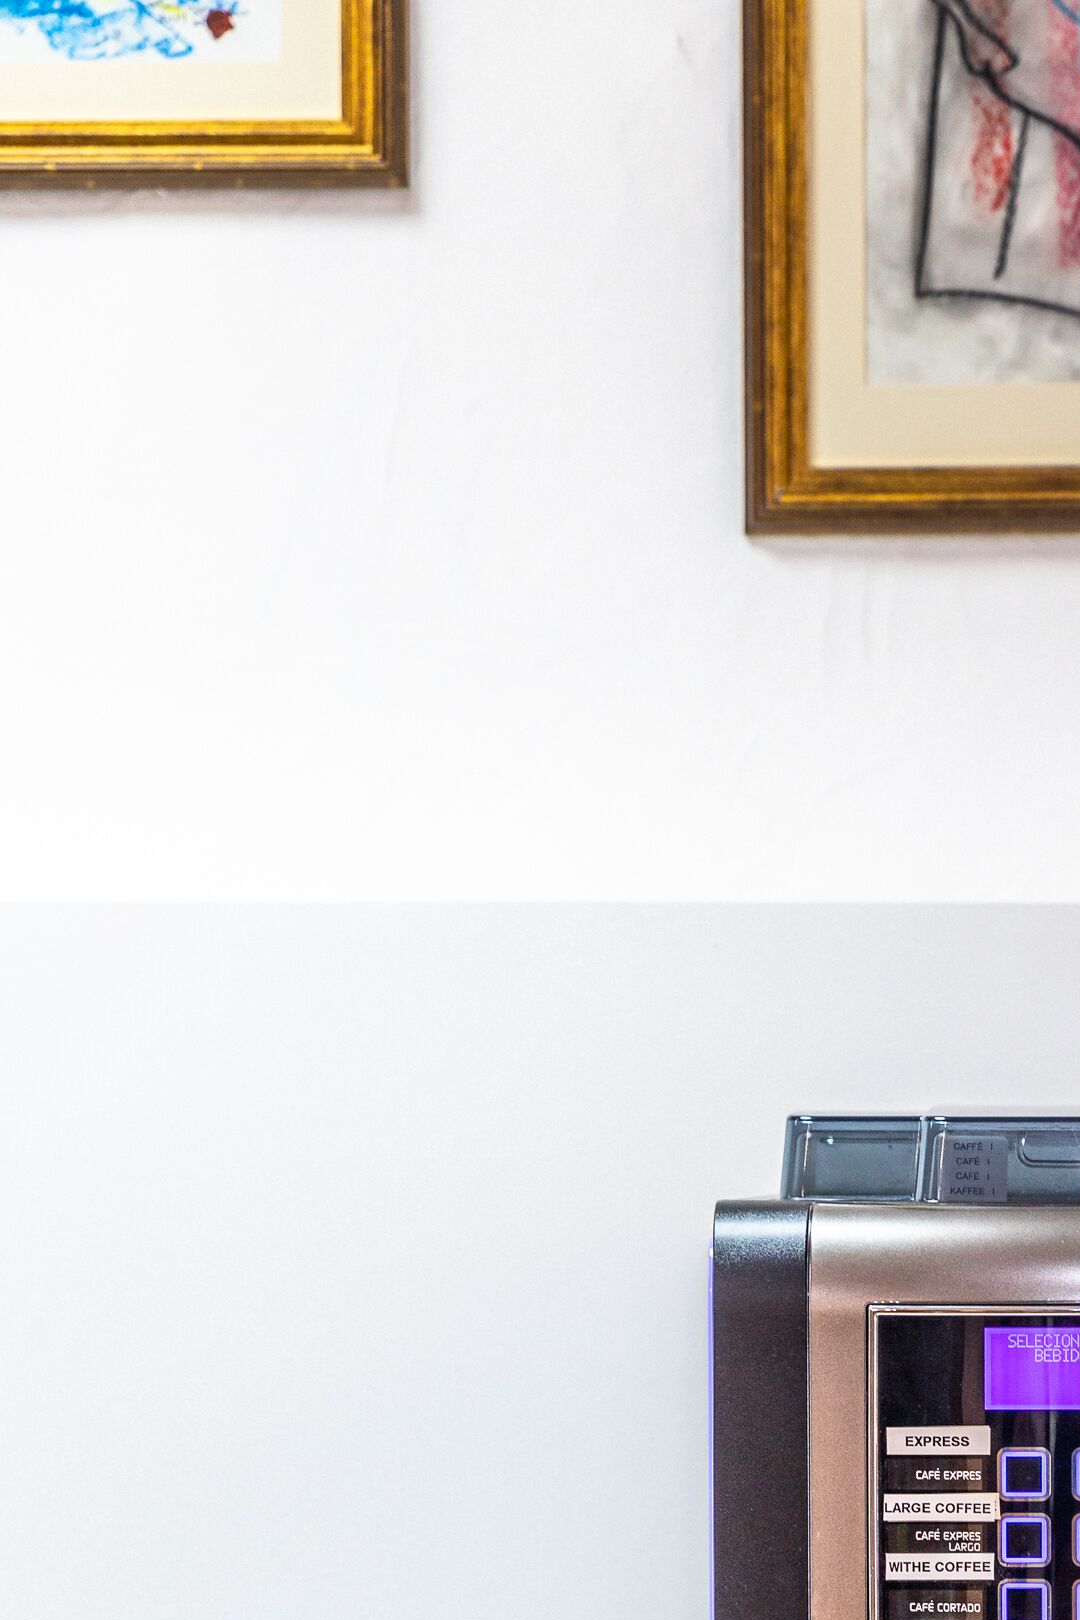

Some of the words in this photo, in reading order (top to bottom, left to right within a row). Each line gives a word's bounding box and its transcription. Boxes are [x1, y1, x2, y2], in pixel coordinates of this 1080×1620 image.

[950, 1186, 984, 1196] KAFFEE
[905, 1436, 970, 1447] EXPRESS
[915, 1467, 941, 1480] CAFÉ
[943, 1470, 982, 1480] EXPRES
[884, 1502, 931, 1513] LARGE
[935, 1503, 991, 1514] COFFEE
[915, 1528, 941, 1540] CAFÉ
[943, 1531, 982, 1541] EXPRES
[948, 1542, 981, 1552] LARGO
[888, 1561, 931, 1573] WITHE
[935, 1561, 991, 1573] COFFEE
[909, 1600, 935, 1612] CAFÉ
[937, 1602, 981, 1613] CORTADO
